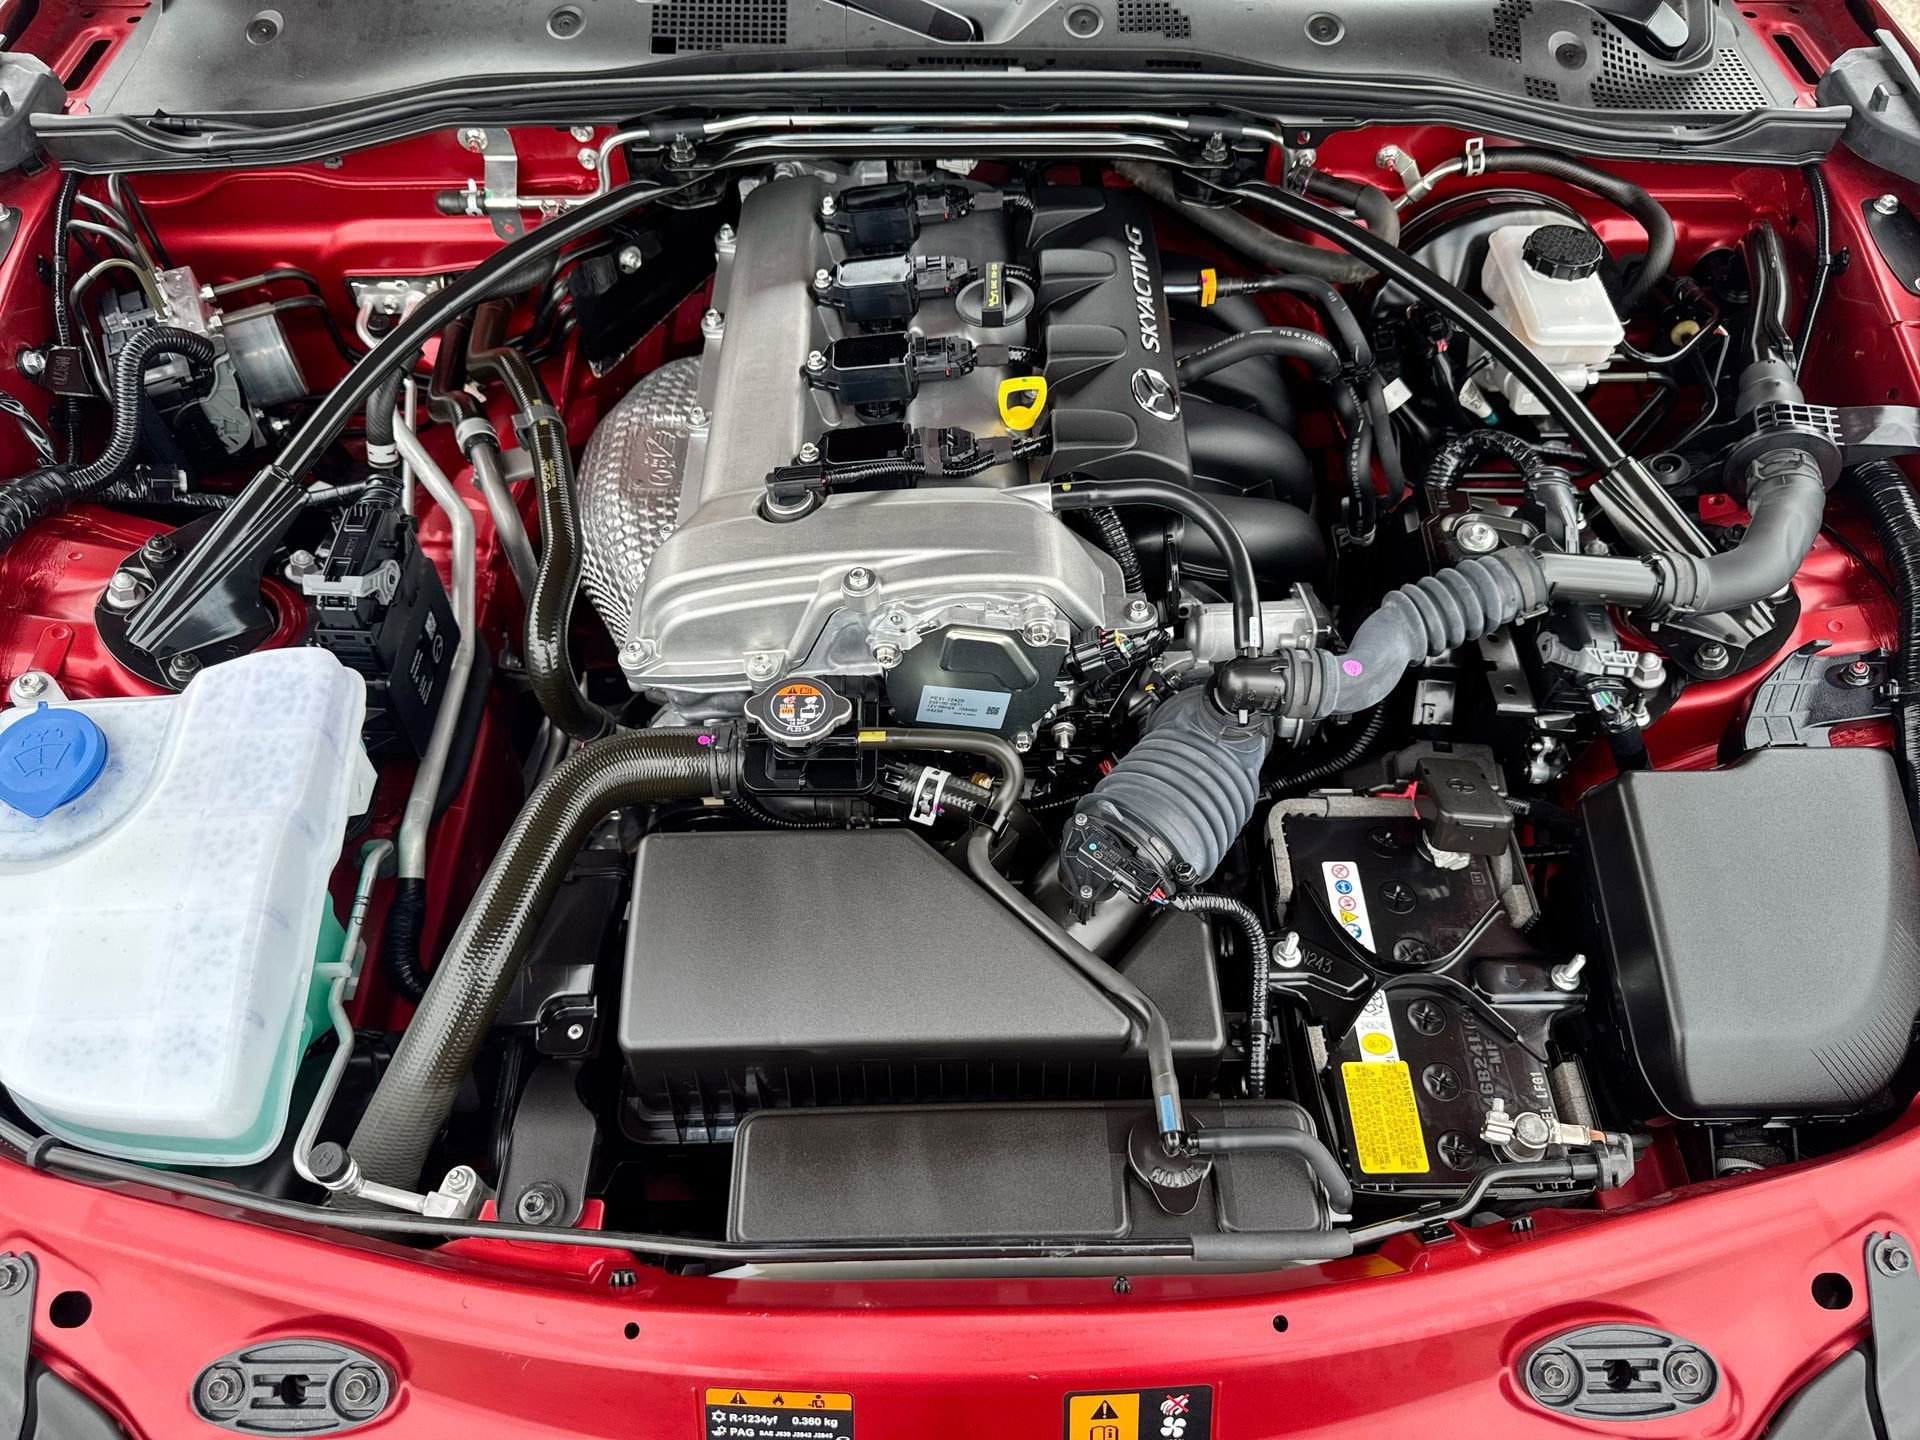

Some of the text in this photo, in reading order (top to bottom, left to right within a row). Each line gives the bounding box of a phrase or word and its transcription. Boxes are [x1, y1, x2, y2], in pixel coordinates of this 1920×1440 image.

[1124, 224, 1160, 354] SKYACTIV-G
[1301, 948, 1334, 974] N243
[1369, 1078, 1382, 1105] POISON
[1400, 1080, 1416, 1113] DANGER
[729, 1414, 838, 1428] R-1234yf 0.360 kg
[730, 1428, 755, 1437] PAG
